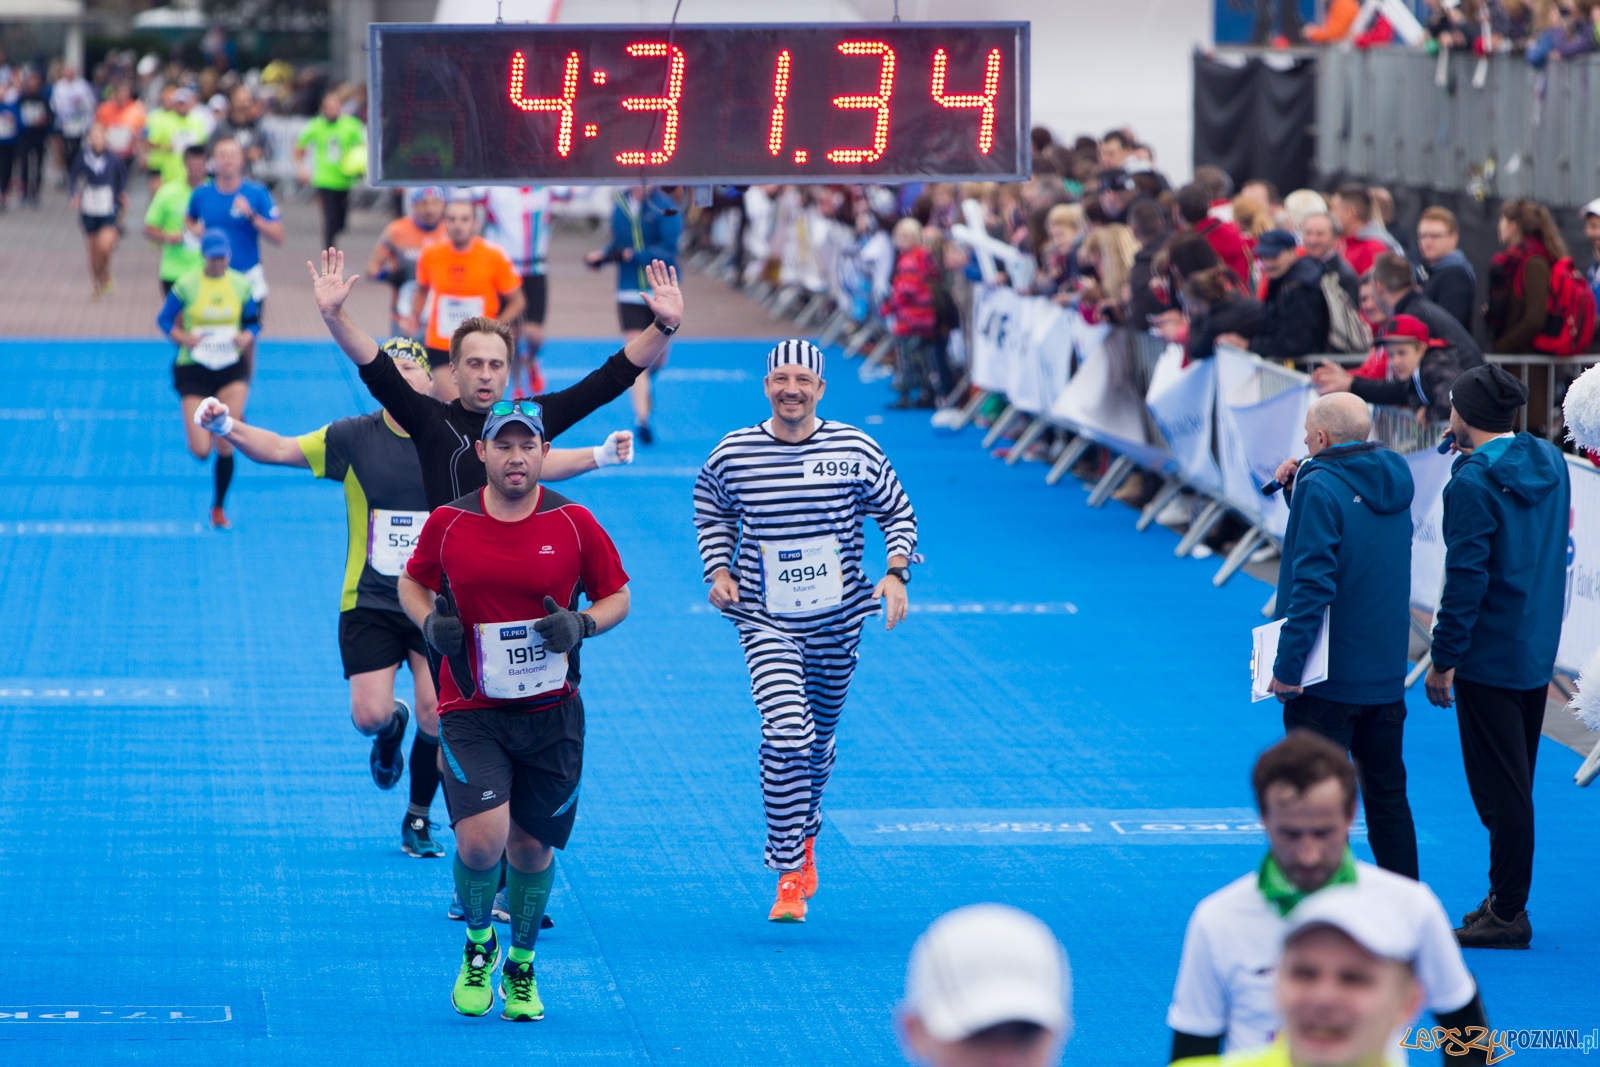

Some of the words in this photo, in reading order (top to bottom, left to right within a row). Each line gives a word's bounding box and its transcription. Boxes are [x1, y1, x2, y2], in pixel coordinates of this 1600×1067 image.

[812, 461, 861, 477] 4994
[780, 552, 801, 560] 17.PKO
[778, 562, 828, 584] 4994
[793, 584, 816, 593] Marek
[502, 629, 526, 638] 17.PKO
[506, 644, 547, 665] 1913
[508, 663, 548, 676] Bartłomiej
